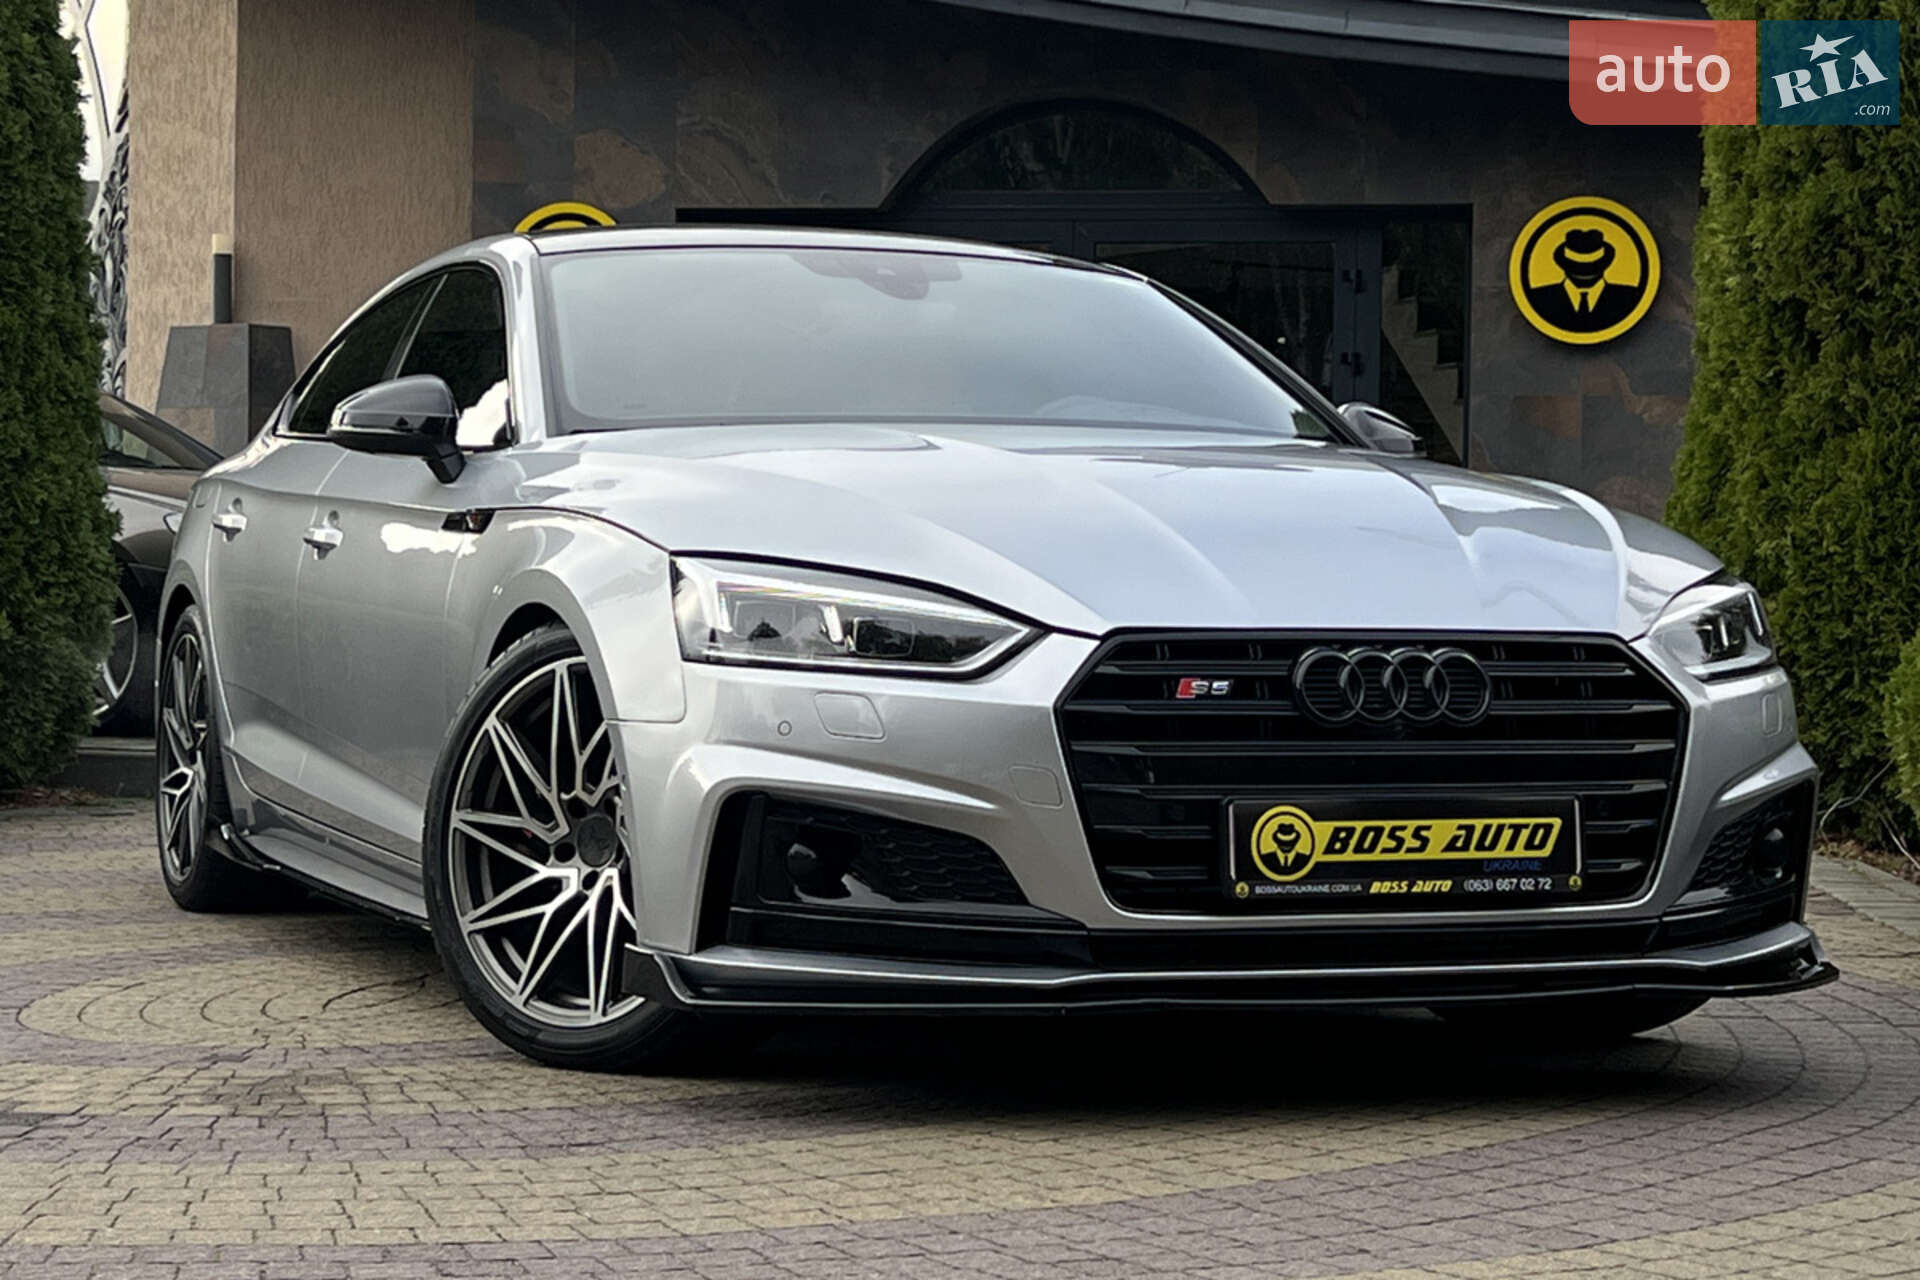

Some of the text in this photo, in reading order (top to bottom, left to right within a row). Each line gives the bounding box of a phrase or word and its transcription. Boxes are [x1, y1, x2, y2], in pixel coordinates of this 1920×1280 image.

[1322, 822, 1555, 855] BOSS AUTO
[1483, 860, 1542, 872] UKRAINE
[1369, 881, 1408, 893] BOSS
[1411, 880, 1453, 893] AUTO
[1464, 880, 1493, 892] (063)
[1495, 879, 1517, 891] 667
[1519, 878, 1535, 890] 02
[1538, 877, 1552, 889] 72
